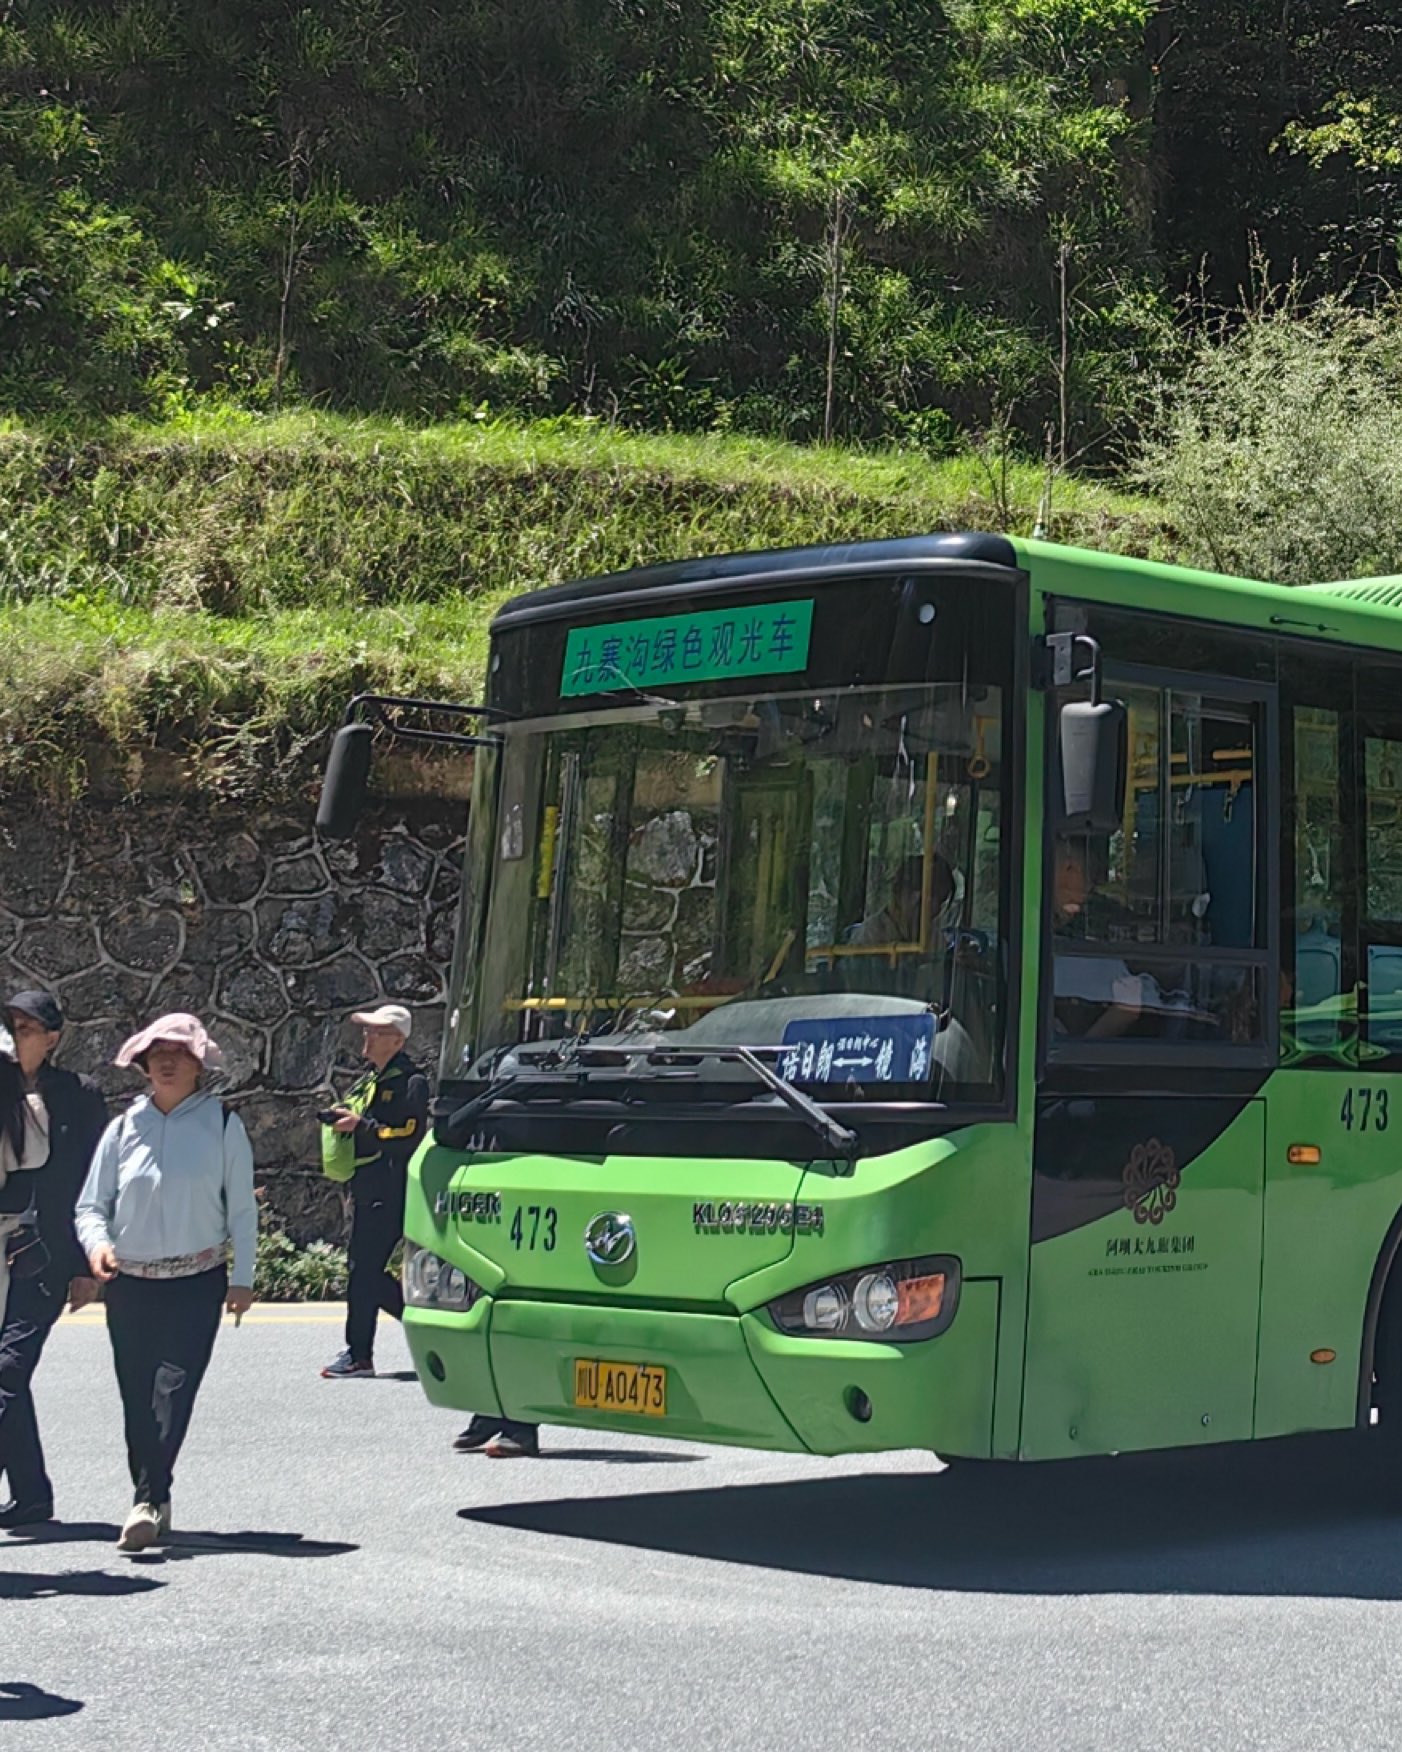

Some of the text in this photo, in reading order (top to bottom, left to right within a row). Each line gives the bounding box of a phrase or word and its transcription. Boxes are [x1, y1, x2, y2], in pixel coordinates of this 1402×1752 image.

[572, 613, 796, 685] 九寨沟绿色观光车
[1340, 1088, 1389, 1132] 473
[434, 1191, 501, 1216] HIGER
[510, 1205, 558, 1252] 473
